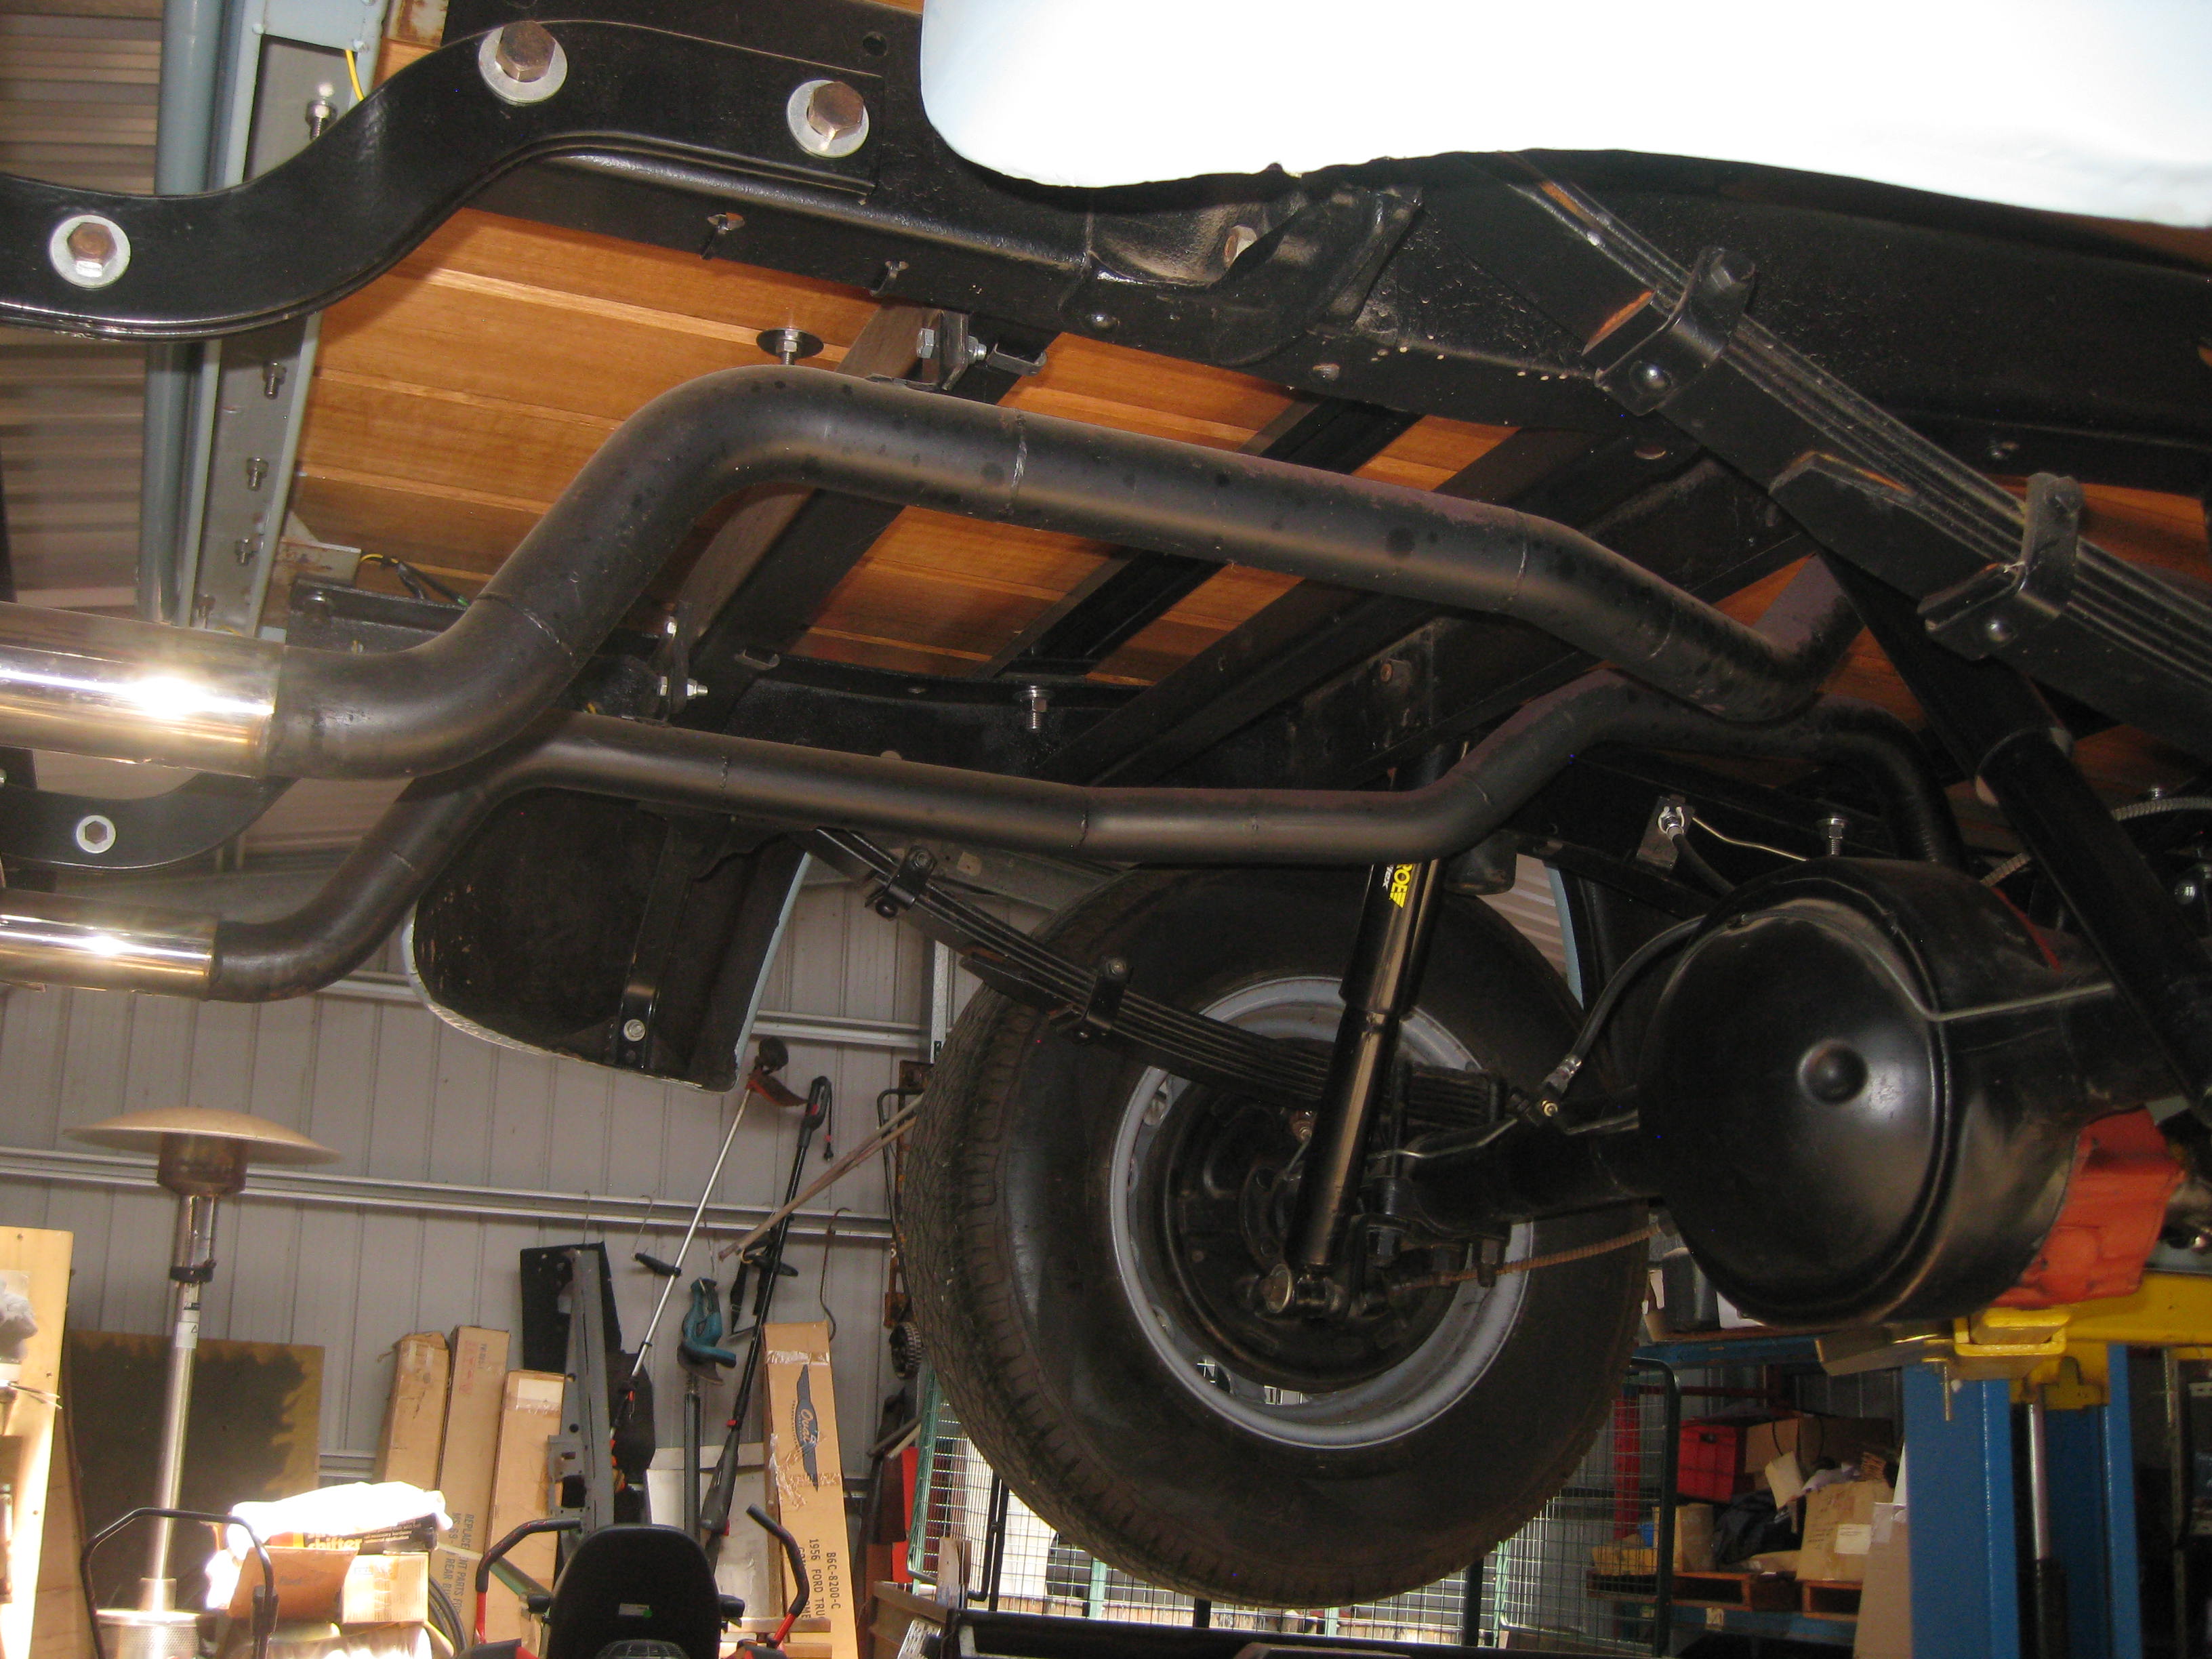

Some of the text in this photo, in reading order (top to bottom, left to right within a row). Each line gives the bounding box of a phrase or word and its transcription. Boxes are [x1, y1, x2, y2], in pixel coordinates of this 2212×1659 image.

[459, 1513, 475, 1570] REPLACEENT
[809, 1539, 825, 1618] 1956 FORD TRU
